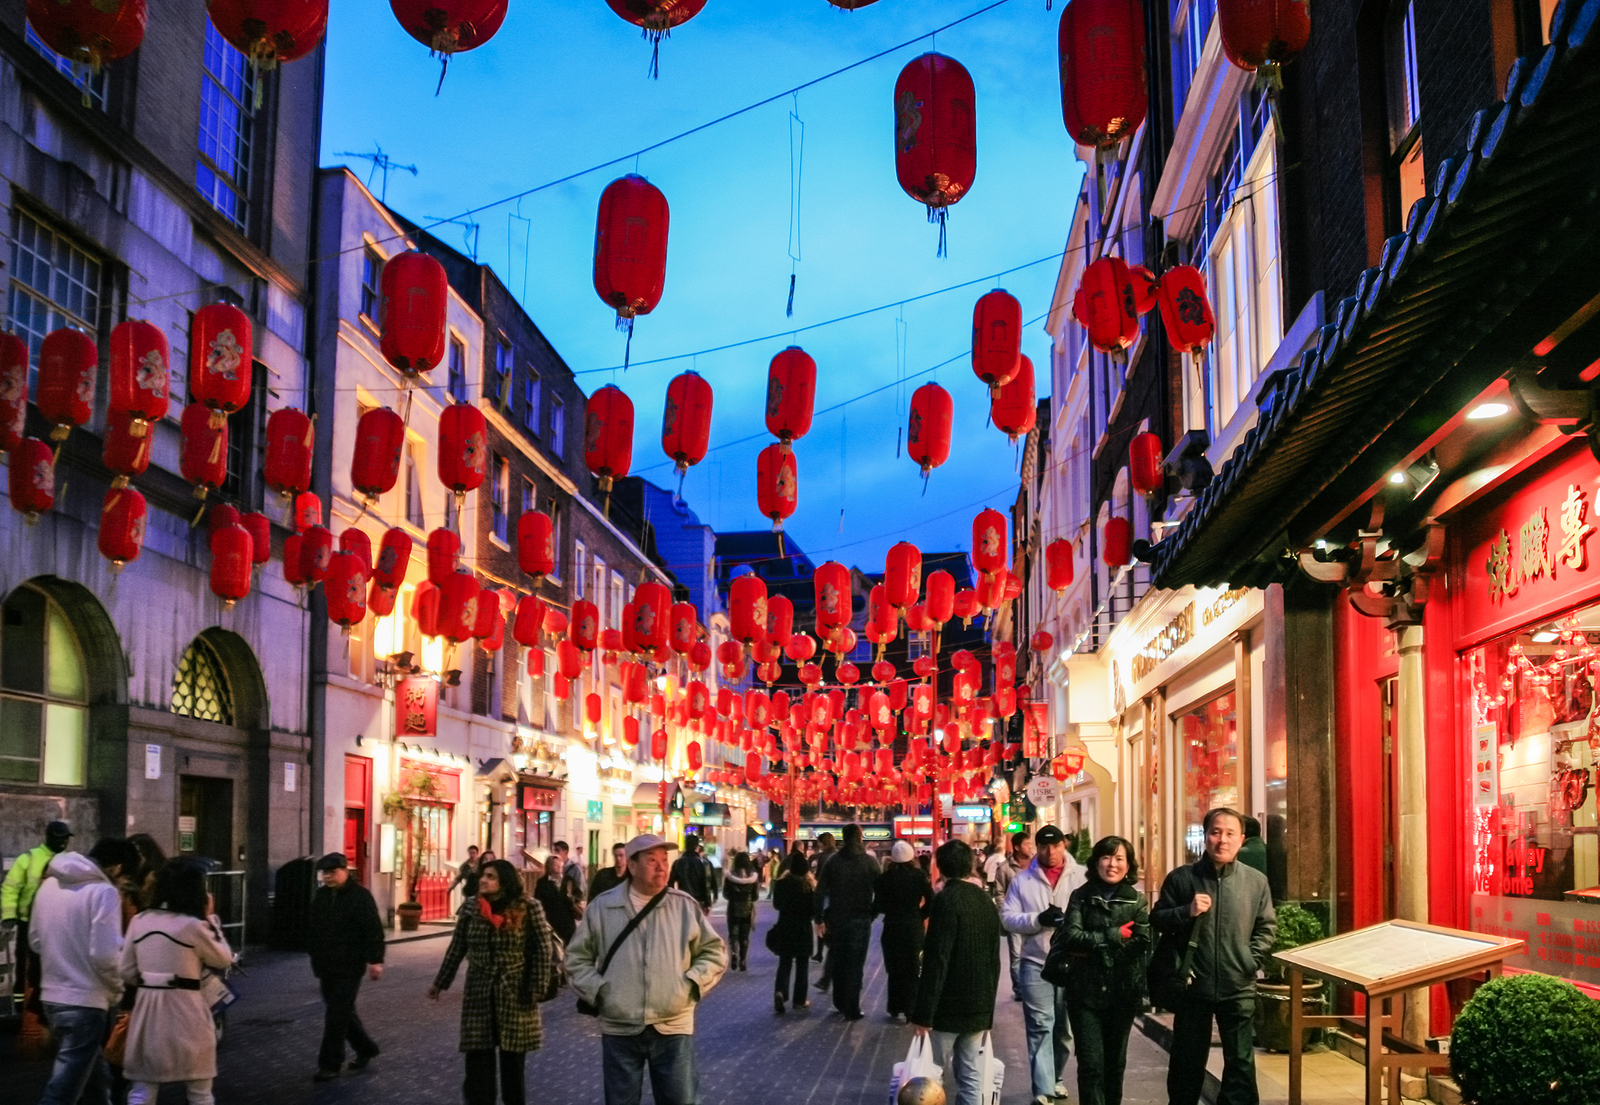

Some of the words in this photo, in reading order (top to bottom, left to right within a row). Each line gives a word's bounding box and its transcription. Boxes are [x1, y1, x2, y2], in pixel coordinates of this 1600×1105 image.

[1486, 484, 1600, 602] 燒臘專
[1032, 788, 1055, 796] HSBC
[1506, 848, 1545, 873] away
[1474, 868, 1534, 895] Weome
